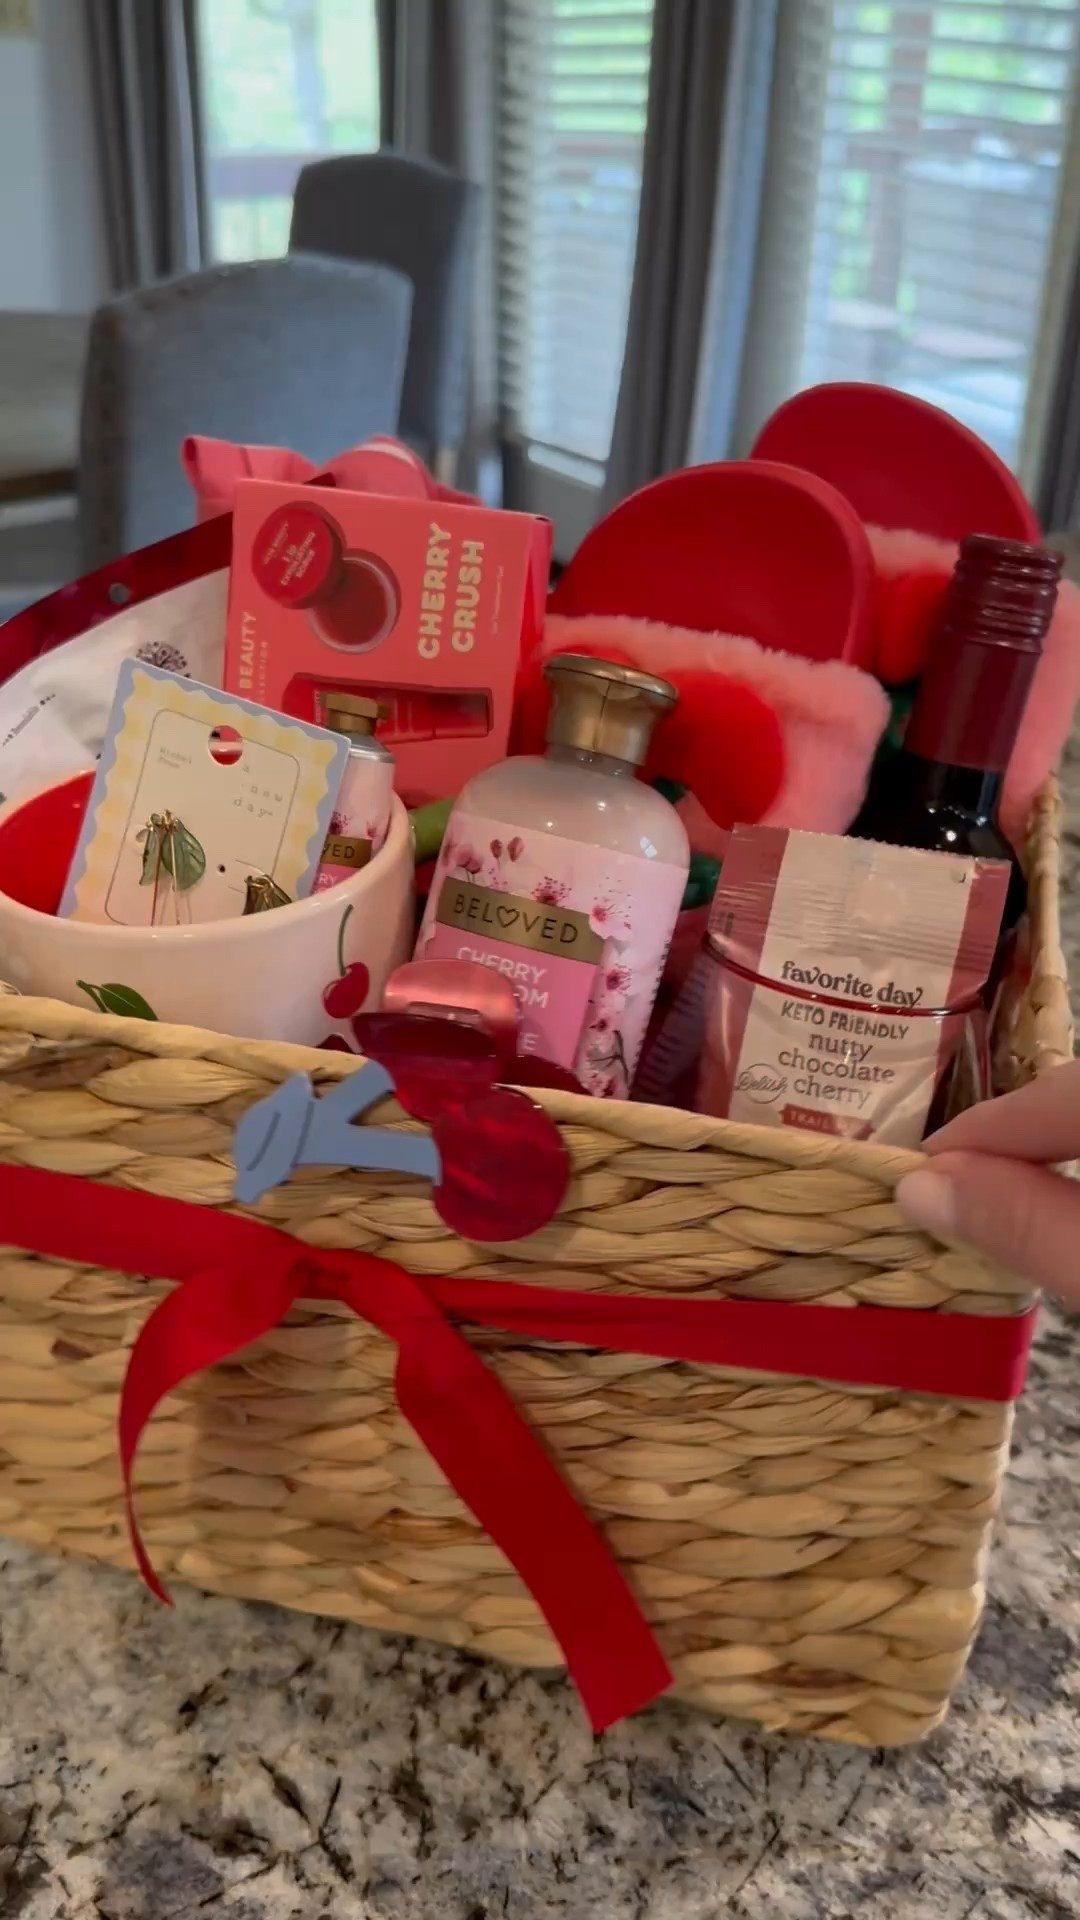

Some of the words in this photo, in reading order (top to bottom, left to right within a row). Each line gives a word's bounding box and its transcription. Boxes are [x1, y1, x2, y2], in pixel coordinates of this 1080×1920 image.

[417, 521, 451, 659] CHERRY
[451, 539, 484, 653] CRUSH
[239, 611, 257, 690] BEAUTY
[781, 960, 873, 998] favorite
[877, 981, 924, 1008] day
[781, 1000, 826, 1025] KETO
[777, 1047, 896, 1085] chocolate
[808, 1033, 874, 1062] nutty
[793, 1076, 871, 1110] cherry
